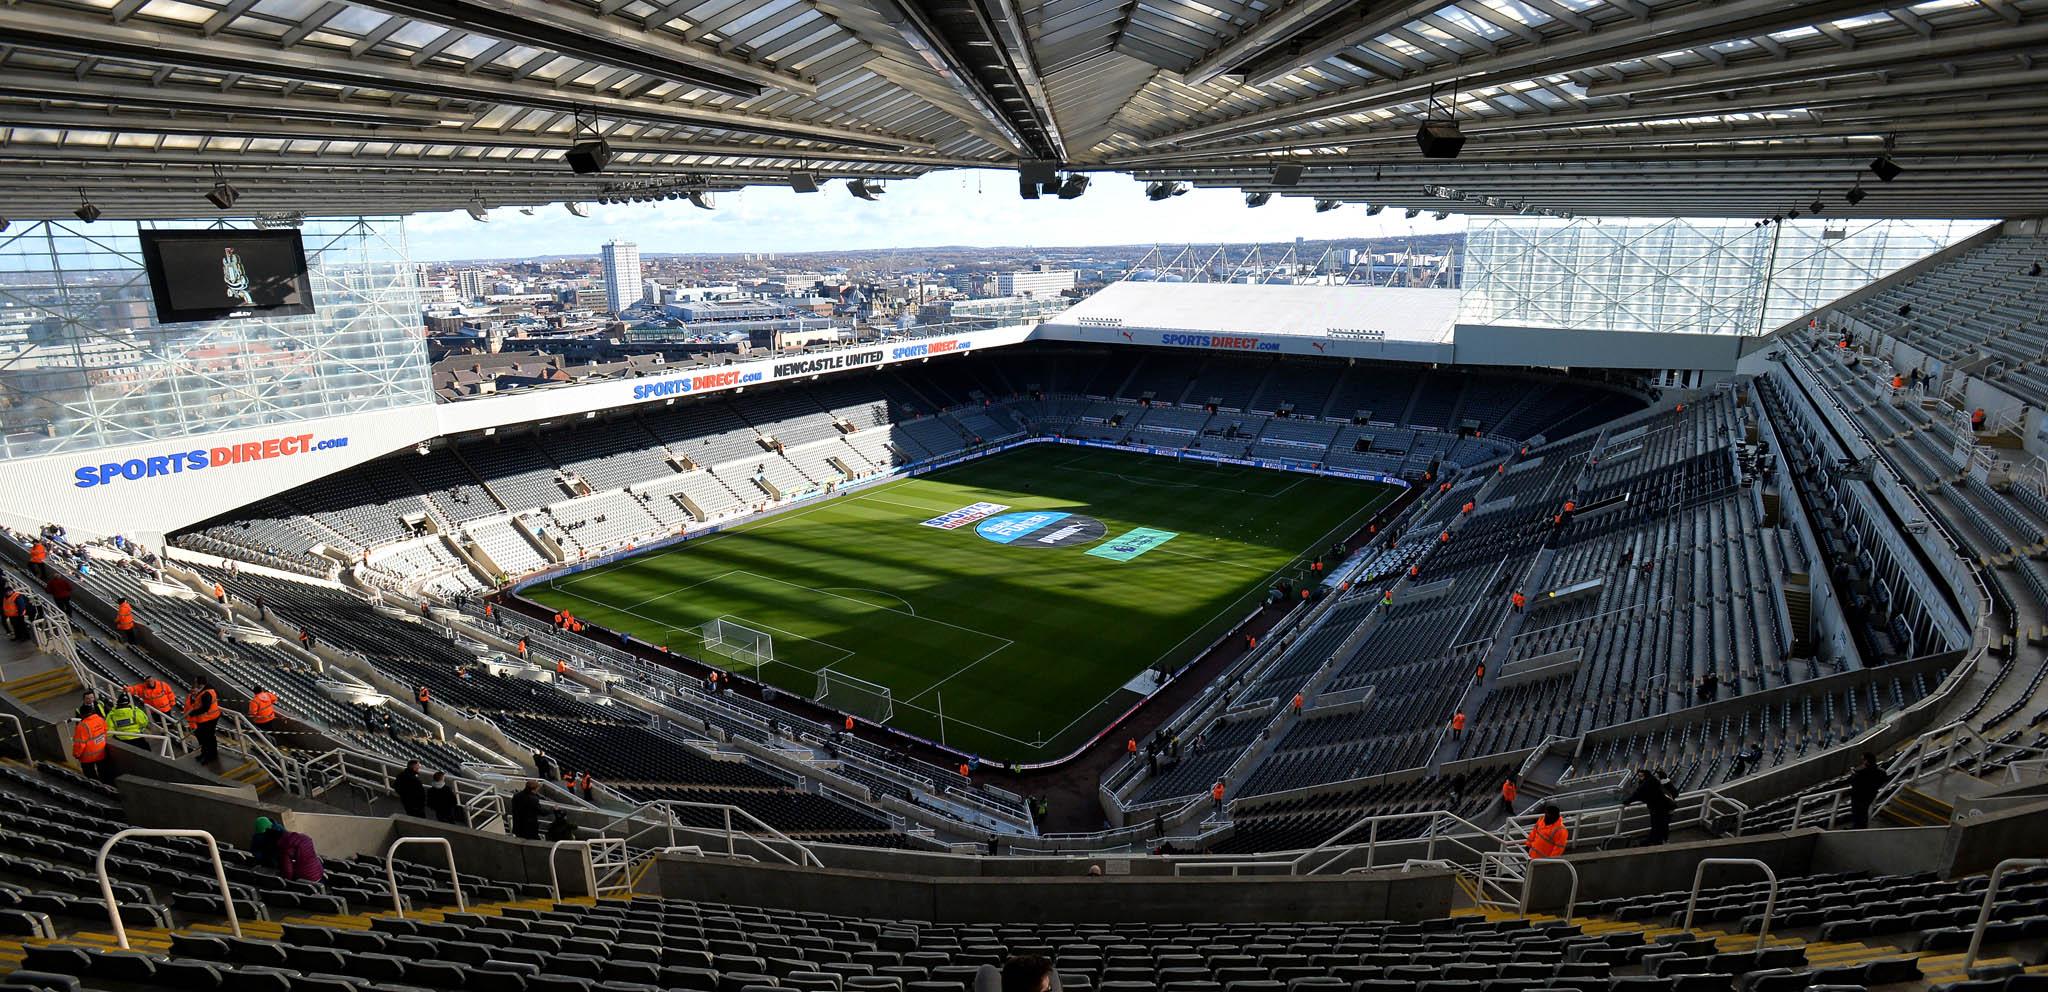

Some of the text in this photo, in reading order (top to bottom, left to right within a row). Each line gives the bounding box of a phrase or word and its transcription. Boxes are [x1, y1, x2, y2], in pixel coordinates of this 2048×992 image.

[1162, 334, 1280, 350] SPORTSDIRECT.COM
[774, 350, 883, 377] NEWCASTLE UNITED
[74, 434, 348, 488] SPORTSDIRECT.COM
[926, 503, 992, 526] SPORTS
[995, 514, 1050, 537] FUN88
